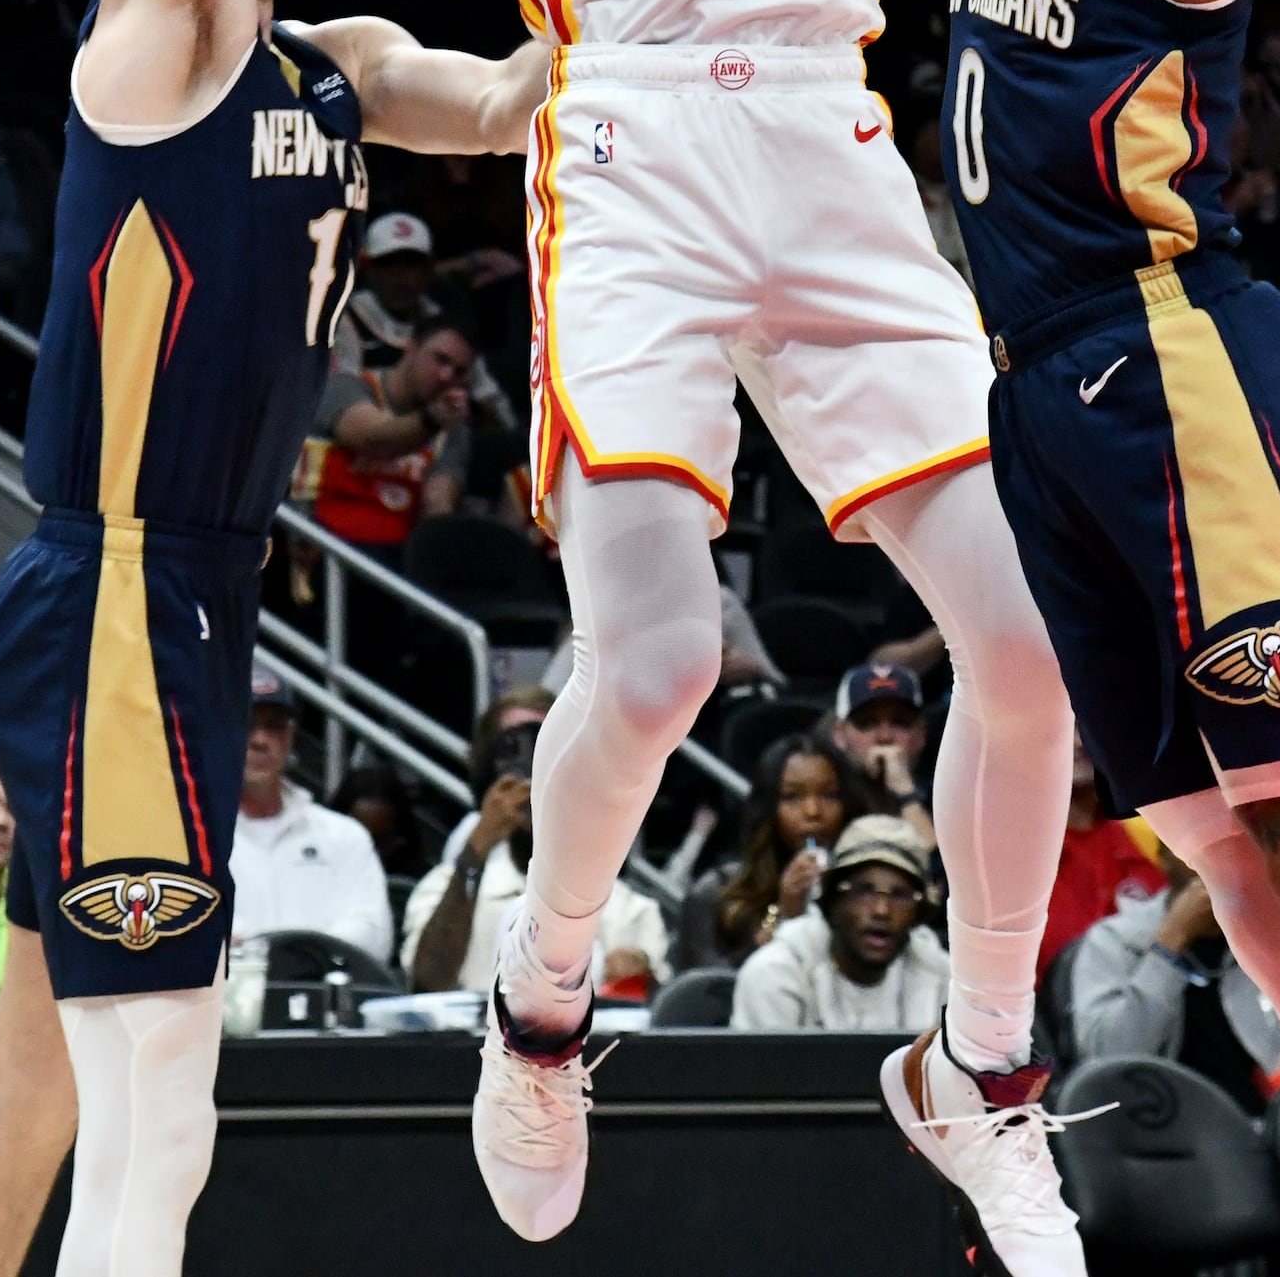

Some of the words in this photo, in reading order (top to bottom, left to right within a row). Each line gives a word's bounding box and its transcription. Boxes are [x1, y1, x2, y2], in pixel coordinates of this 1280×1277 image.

[709, 62, 756, 77] HAWKS
[251, 108, 329, 180] NEW
[952, 46, 991, 206] 0
